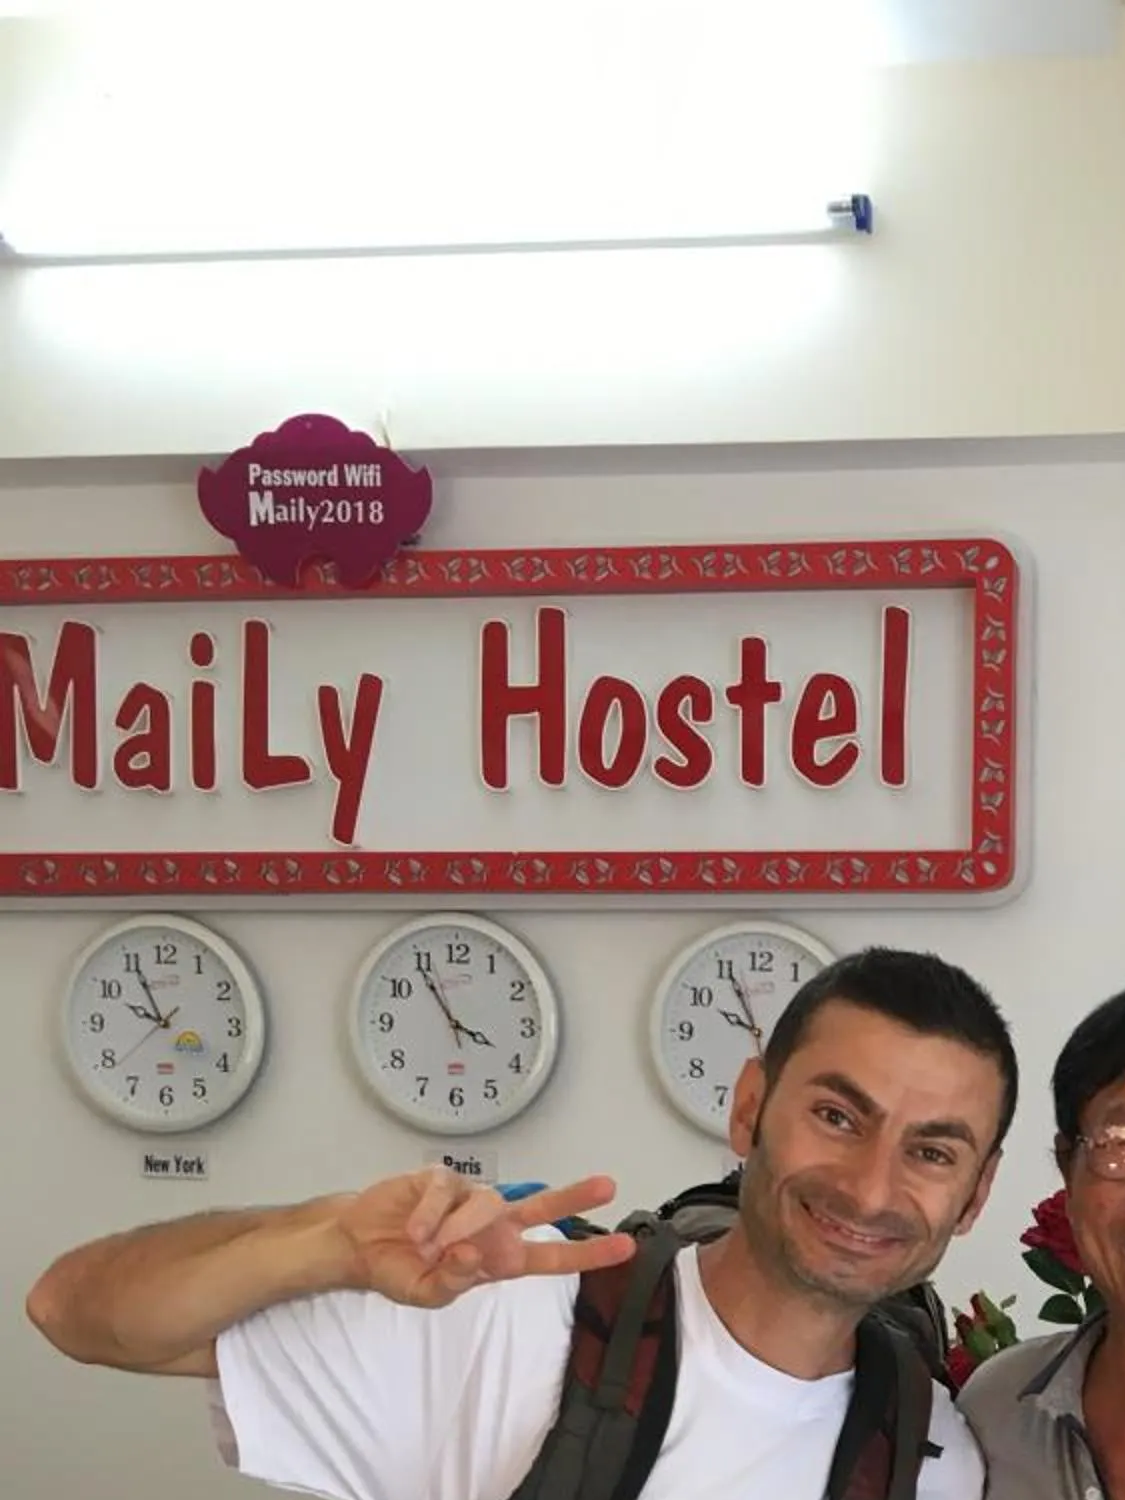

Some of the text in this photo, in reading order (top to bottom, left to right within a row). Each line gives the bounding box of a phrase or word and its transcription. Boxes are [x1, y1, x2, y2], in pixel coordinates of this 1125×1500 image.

[248, 463, 382, 487] Password Wifi
[248, 489, 384, 531] Maily2018
[0, 604, 911, 847] MaiLy Hostel
[124, 953, 142, 973] 11
[153, 944, 178, 966] 12
[193, 954, 203, 975] 1
[415, 951, 432, 973] 11
[446, 943, 471, 965] 12
[486, 954, 496, 975] 1
[748, 951, 774, 973] 12
[717, 959, 734, 980] 11
[789, 962, 799, 983] 1
[100, 979, 122, 1000] 10
[216, 981, 232, 1002] 2
[390, 978, 413, 1000] 10
[509, 981, 526, 1002] 2
[689, 987, 713, 1008] 10
[89, 1013, 105, 1033] 9
[227, 1017, 243, 1038] 3
[378, 1013, 394, 1033] 9
[520, 1017, 536, 1039] 3
[678, 1021, 694, 1041] 9
[100, 1049, 117, 1069] 8
[215, 1052, 230, 1073] 4
[390, 1049, 406, 1070] 8
[508, 1052, 522, 1074] 4
[688, 1058, 705, 1079] 8
[125, 1076, 140, 1097] 7
[158, 1085, 174, 1107] 6
[192, 1077, 207, 1099] 5
[415, 1076, 430, 1097] 7
[483, 1079, 499, 1100] 5
[714, 1085, 729, 1107] 7
[449, 1088, 465, 1108] 6
[144, 1154, 205, 1174] New York
[443, 1155, 482, 1175] Paris
